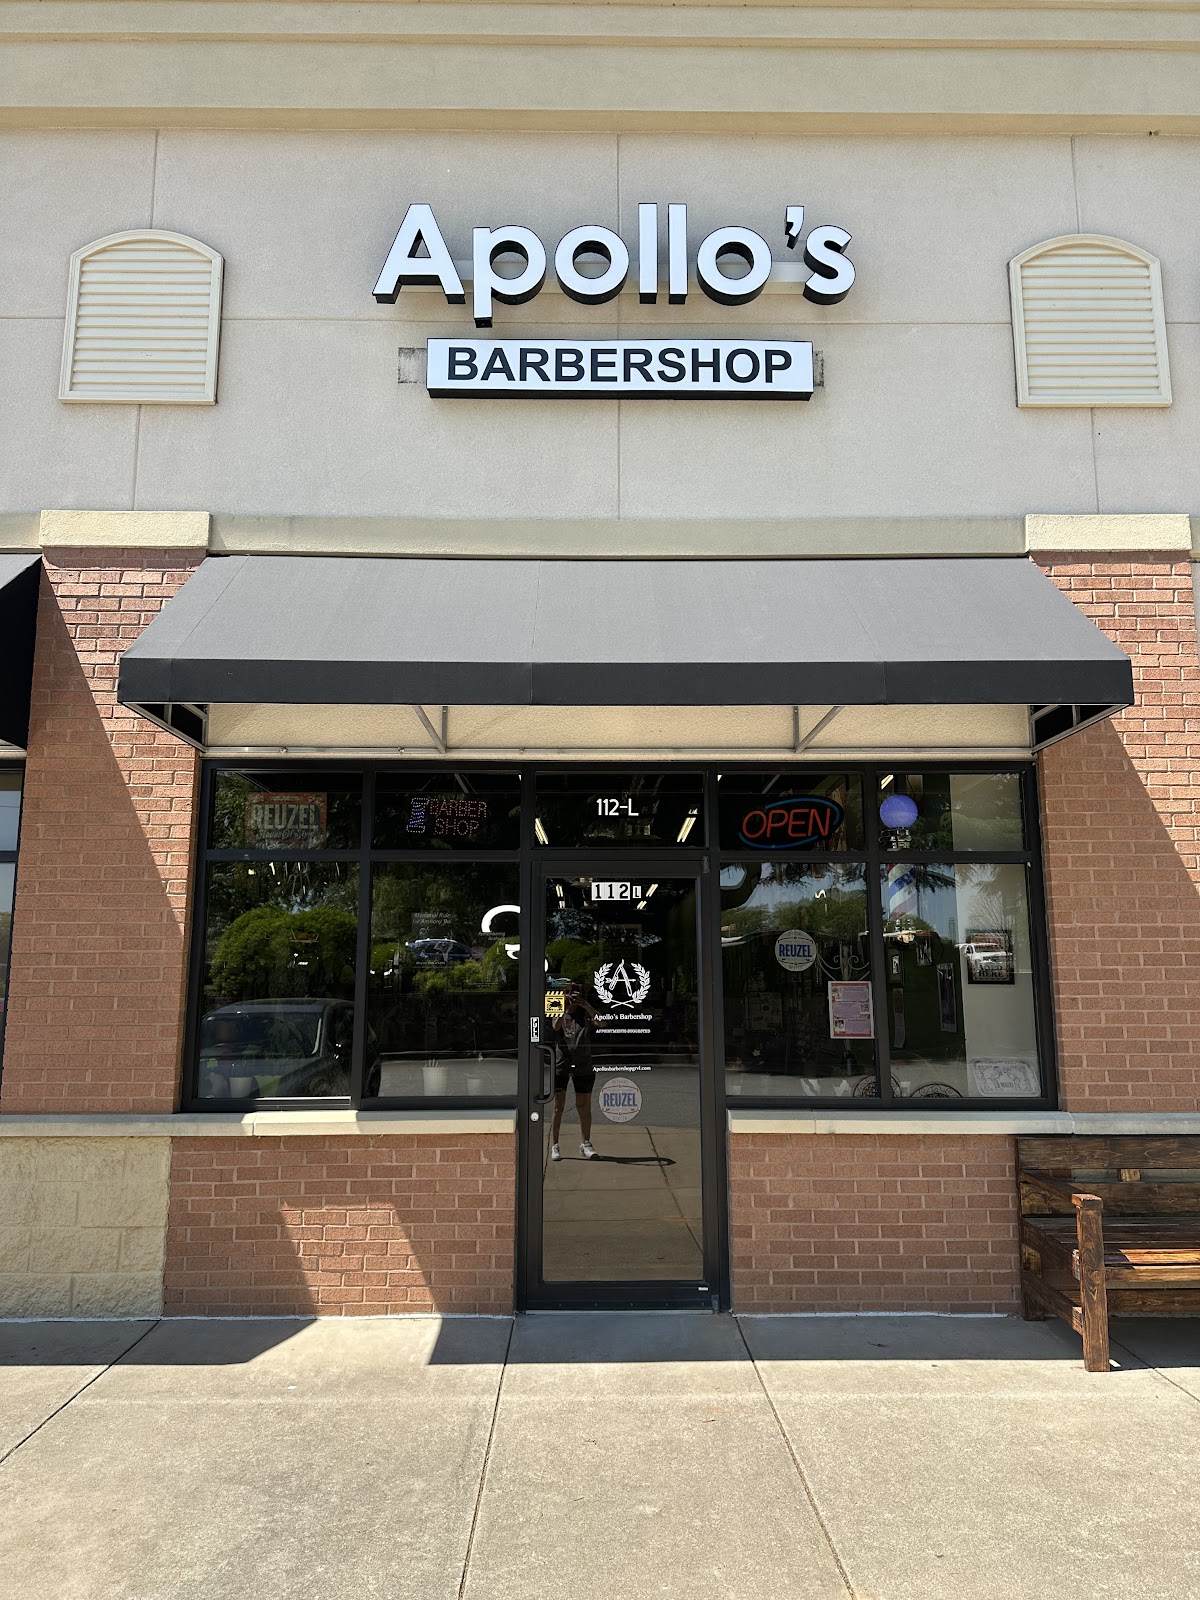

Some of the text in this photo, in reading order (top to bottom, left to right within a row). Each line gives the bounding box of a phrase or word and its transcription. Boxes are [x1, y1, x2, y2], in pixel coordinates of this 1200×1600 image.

[372, 203, 856, 326] Apollo's
[447, 347, 793, 384] BARBERSHOP
[250, 804, 319, 829] REUZEL
[429, 798, 487, 818] BARBER
[596, 798, 639, 816] 112-L
[434, 818, 479, 837] SHOP
[742, 808, 831, 839] OPEN
[595, 883, 629, 899] 112
[779, 943, 813, 958] REUZEL
[594, 1013, 653, 1022] Apollo's Barbershop
[603, 1092, 638, 1107] REUZEL
